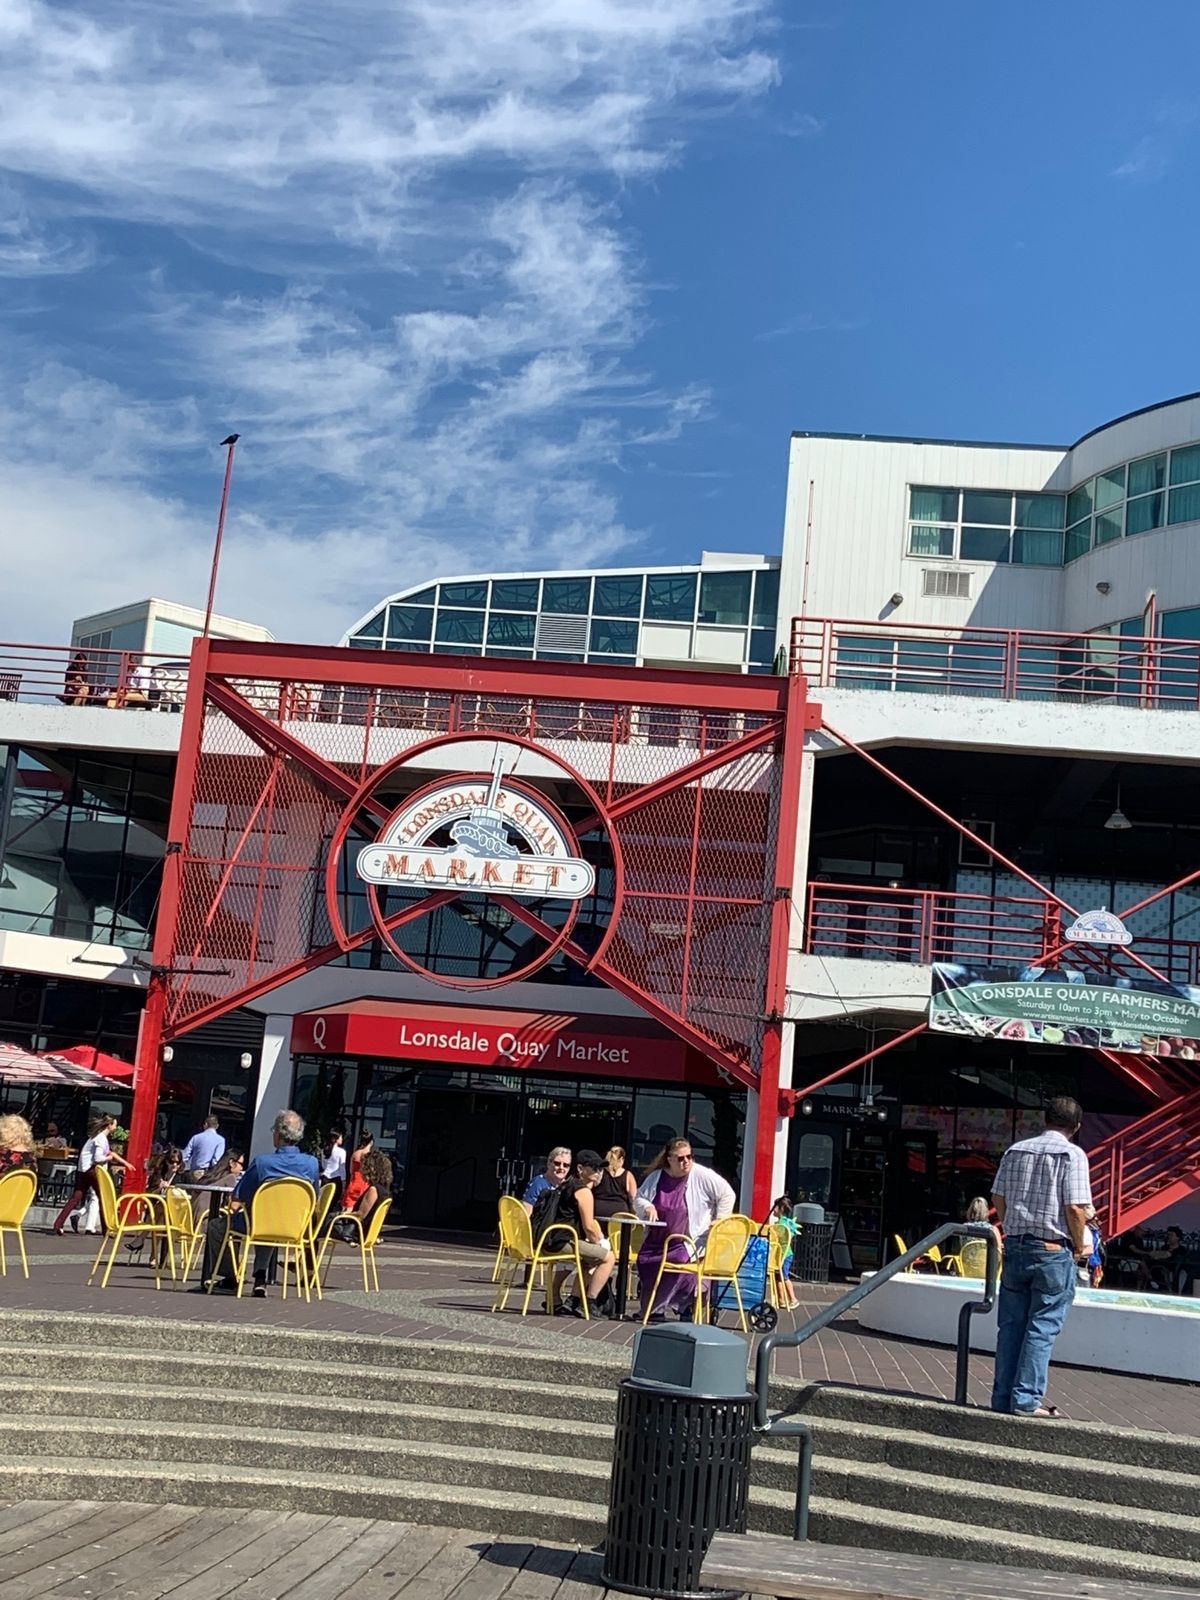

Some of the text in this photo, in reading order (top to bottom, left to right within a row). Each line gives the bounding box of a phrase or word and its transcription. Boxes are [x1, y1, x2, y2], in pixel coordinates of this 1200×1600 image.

[402, 789, 559, 853] LONSDALE QUAY
[386, 853, 567, 888] MARKET
[1072, 930, 1125, 941] MARKET
[972, 987, 1053, 1002] LONSDALE
[1056, 988, 1098, 1001] QUAY
[1102, 992, 1170, 1012] FARMERS
[1017, 998, 1190, 1025] Saturdays 10am to 3pm May to October
[313, 1017, 326, 1050] Q
[400, 1024, 630, 1063] Lonsdale Quay Market
